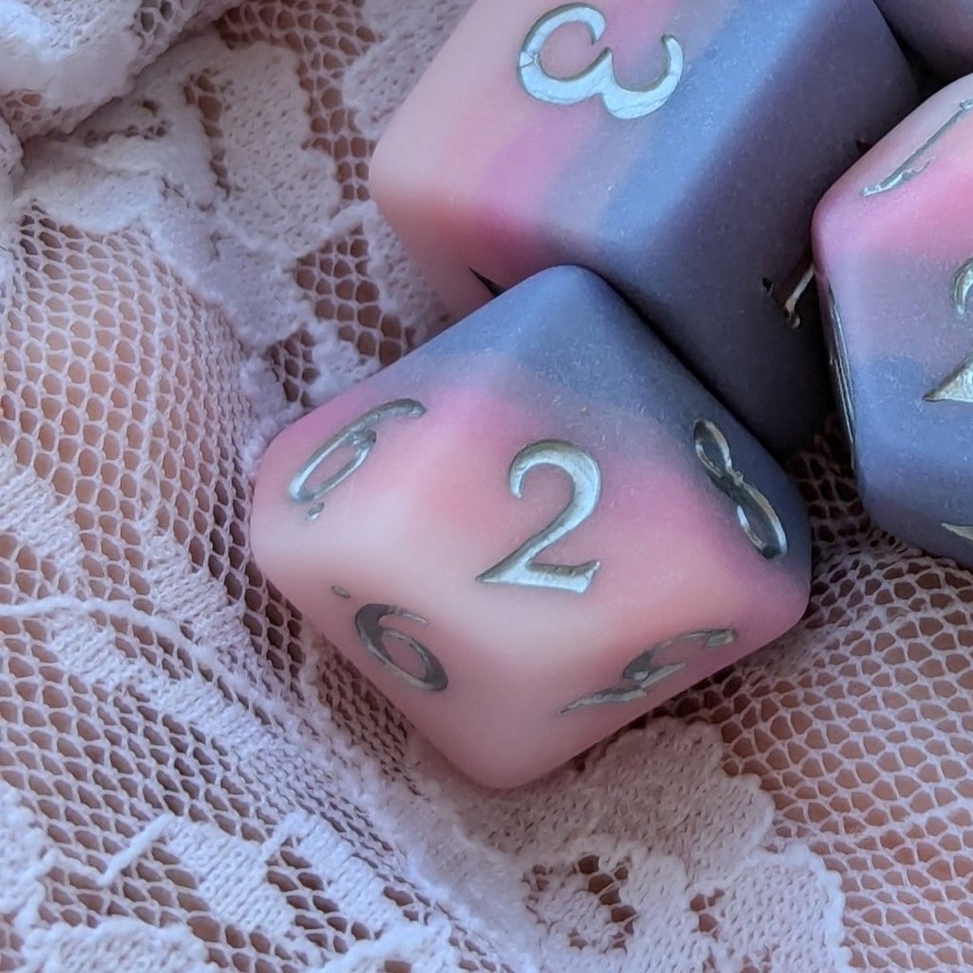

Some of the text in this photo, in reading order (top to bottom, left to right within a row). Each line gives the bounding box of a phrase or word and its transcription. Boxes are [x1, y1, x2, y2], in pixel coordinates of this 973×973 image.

[516, 1, 685, 121] 3
[474, 438, 601, 596] 2
[692, 416, 789, 561] 8
